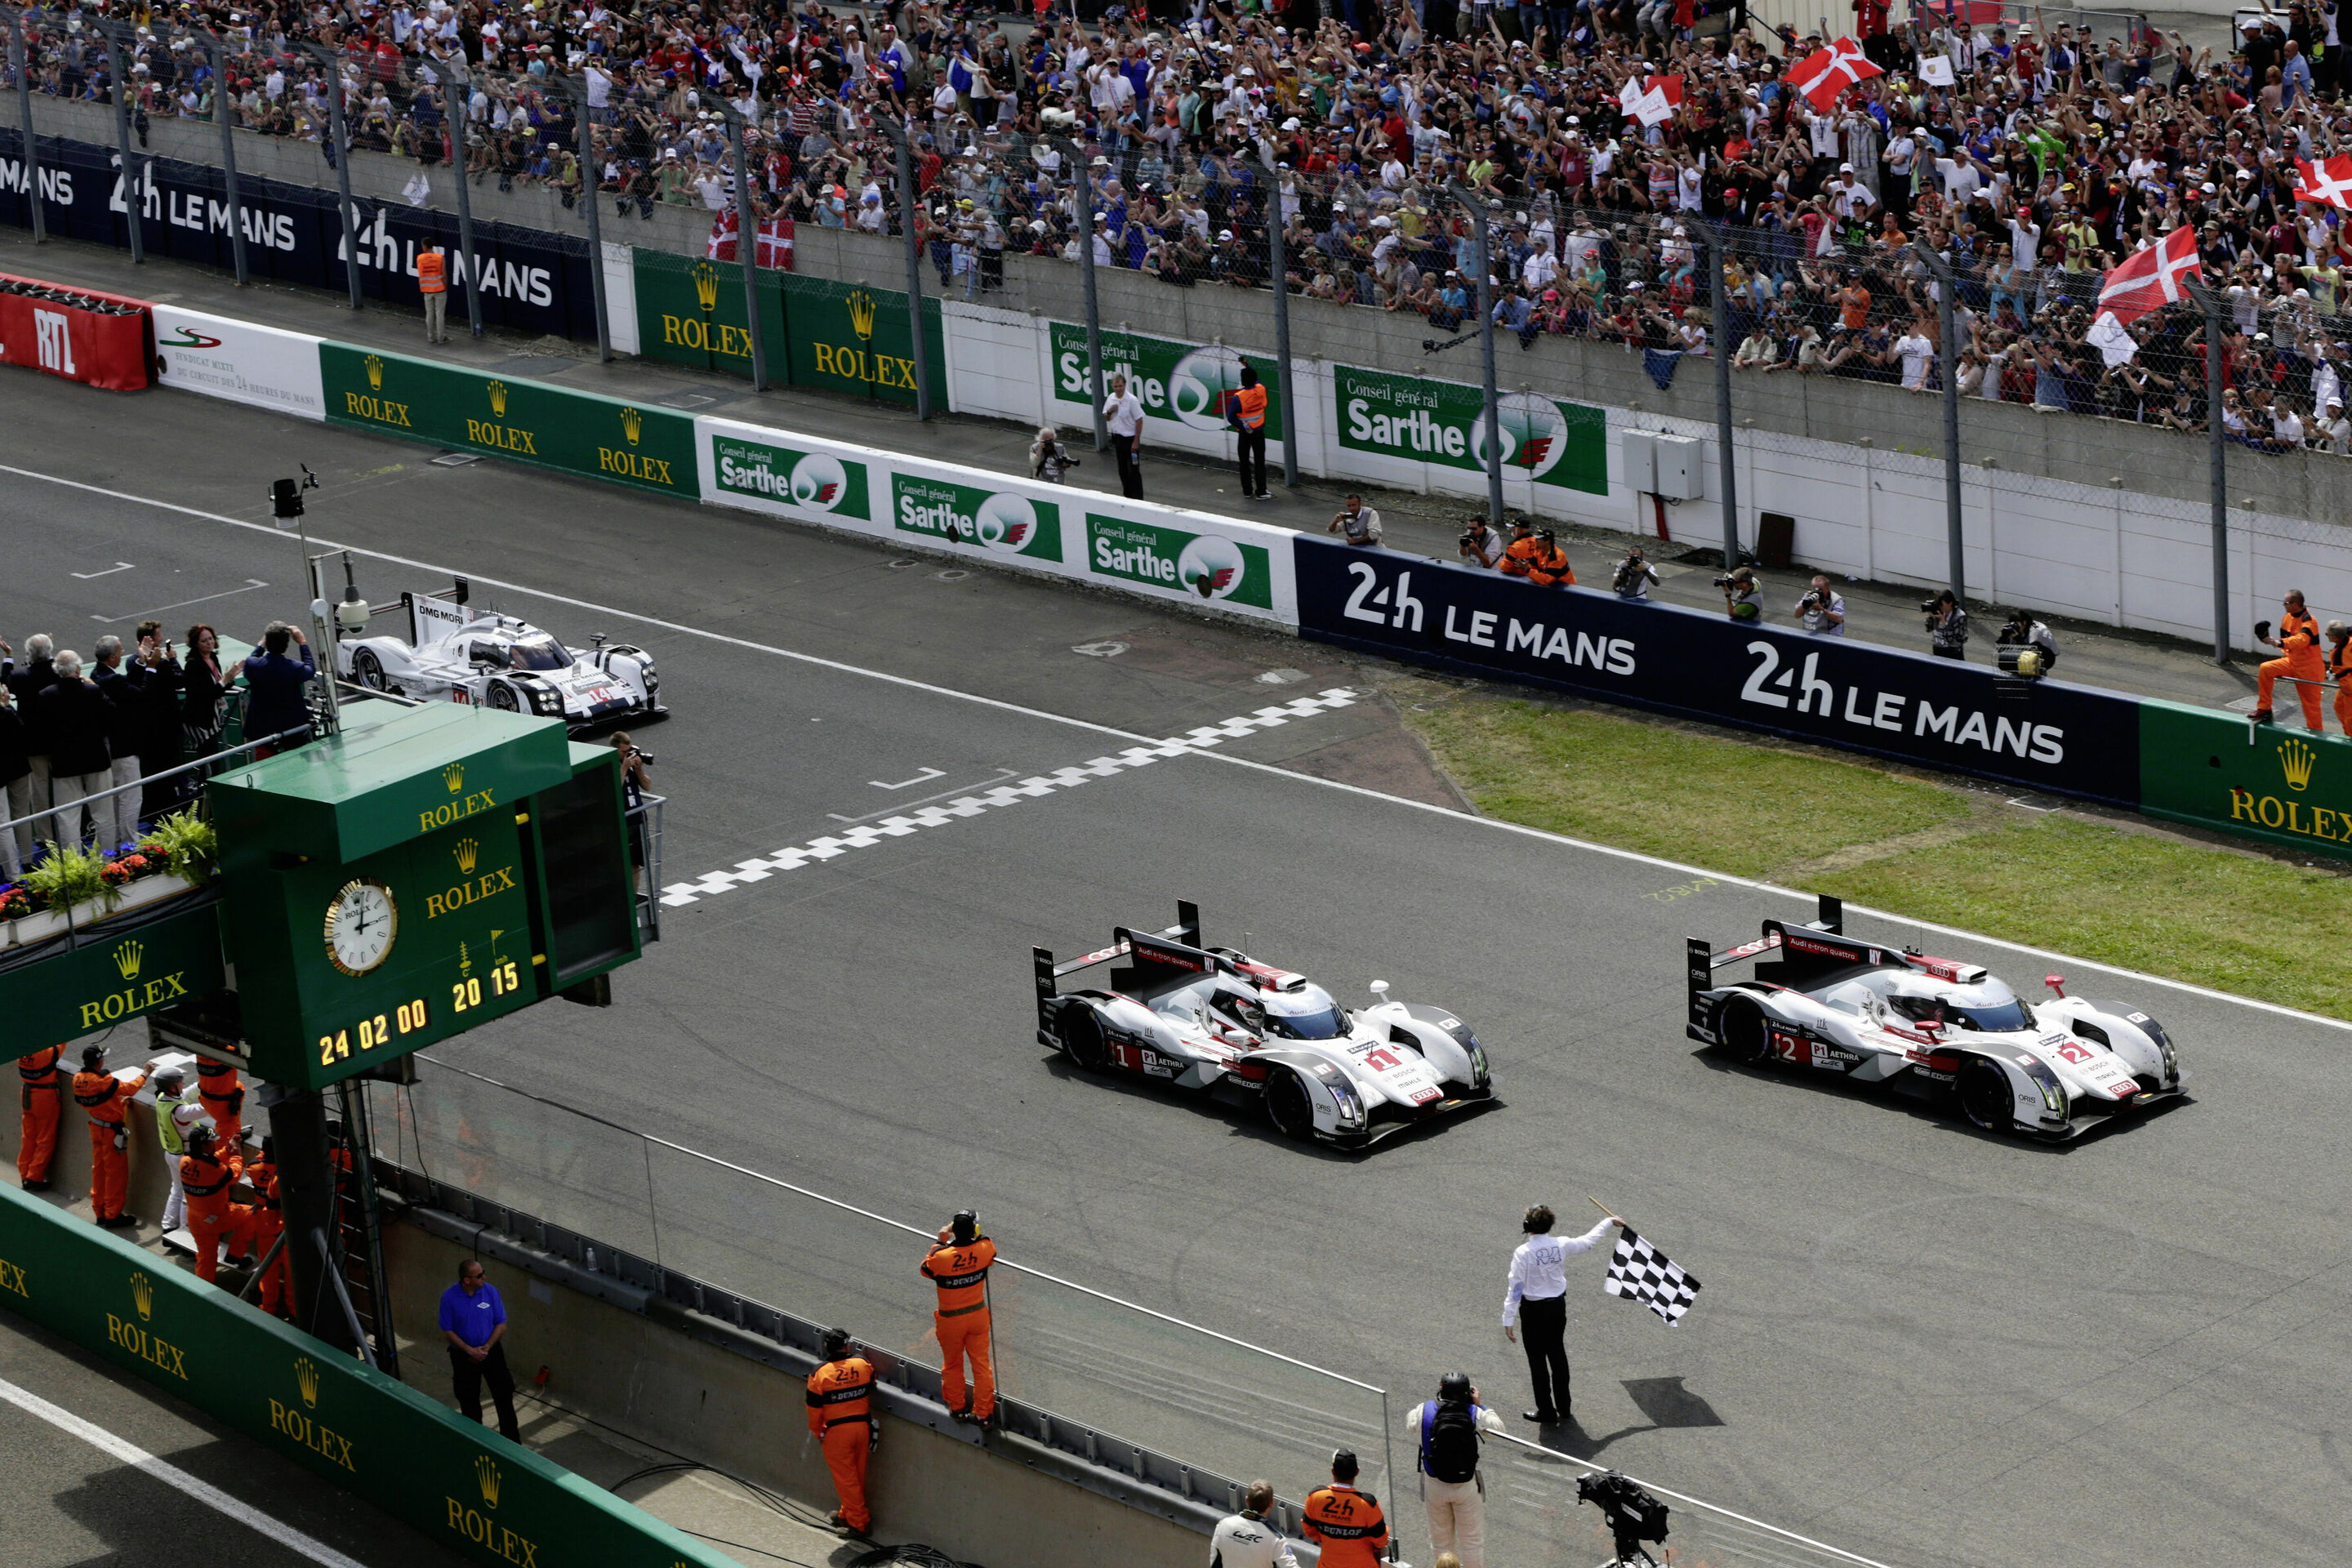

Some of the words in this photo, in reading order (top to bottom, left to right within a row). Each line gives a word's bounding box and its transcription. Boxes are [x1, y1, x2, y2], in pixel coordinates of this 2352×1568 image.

[170, 190, 203, 231] LE
[208, 199, 296, 252] MANS
[338, 202, 398, 273] 24h
[452, 249, 552, 307] MANS
[33, 308, 75, 375] RTL
[1058, 332, 1089, 352] Conse
[175, 351, 210, 368] SYNDICAT
[212, 358, 234, 372] MIXTE
[813, 342, 917, 390] ROLEX
[177, 368, 188, 376] DU
[190, 369, 219, 385] CIRCUIT
[221, 376, 235, 388] DES
[236, 375, 247, 391] 24
[249, 383, 278, 399] HEURES
[281, 390, 292, 400] DU
[294, 394, 315, 405] MANS
[1347, 377, 1391, 402] Conseil
[345, 392, 412, 427] ROLEX
[466, 419, 537, 455] ROLEX
[1348, 398, 1465, 457] Sarthe
[719, 443, 746, 460] Conseil
[746, 450, 773, 464] général
[598, 447, 674, 485] ROLEX
[720, 457, 789, 497] Sarthe
[899, 480, 927, 498] Conseil
[929, 488, 956, 503] général
[900, 494, 973, 537] Sarthe
[1094, 521, 1125, 540] Conseil
[1127, 529, 1157, 546] général
[1095, 537, 1176, 582] Sarthe
[419, 605, 439, 618] DMG
[441, 611, 463, 625] MORI
[1343, 561, 1423, 632] 24h
[1444, 604, 1498, 648] LE
[1506, 617, 1636, 676] MANS
[588, 687, 612, 703] 14
[1740, 641, 1833, 717] 24h
[1844, 686, 1906, 732] LE
[1915, 701, 2064, 764] MANS
[420, 788, 497, 832] ROLEX
[425, 866, 516, 919] ROLEX
[345, 905, 371, 920] ROLEX
[1138, 947, 1152, 956] Audi
[1153, 952, 1171, 961] e-tron
[1171, 958, 1193, 968] quattro
[1695, 949, 1709, 957] BOSCH
[1790, 938, 1806, 947] Audi
[1807, 943, 1829, 953] e-tron
[1829, 949, 1855, 960] quattro
[1869, 948, 1882, 965] HY
[1204, 956, 1214, 973] HY
[1691, 969, 1707, 978] ORIS
[491, 962, 519, 996] 15
[1038, 976, 1052, 986] ORIS
[79, 971, 188, 1029] ROLEX
[452, 978, 481, 1013] 20
[319, 1028, 350, 1066] 24
[359, 1014, 388, 1050] 02
[397, 999, 426, 1034] 00
[1444, 1020, 1458, 1028] P1
[1116, 1045, 1129, 1067] 1
[1144, 1052, 1155, 1064] P1
[1783, 1037, 1796, 1061] 2
[1814, 1045, 1825, 1056] P1
[1830, 1050, 1859, 1061] AETHRA
[2062, 1047, 2090, 1064] 2
[1158, 1058, 1184, 1068] AETHRA
[1371, 1054, 1396, 1071] 1
[1392, 1067, 1416, 1079] BOSCH
[2087, 1061, 2109, 1071] BOSCH
[1242, 1080, 1263, 1089] EDGE
[1397, 1078, 1423, 1089] MAHLE
[1931, 1071, 1956, 1082] EDGE
[2095, 1070, 2118, 1080] MAHLE
[1316, 1102, 1331, 1112] ORIS
[2018, 1094, 2036, 1103] ORIS
[952, 1251, 978, 1267] 24h
[952, 1272, 983, 1285] DUNLOP
[106, 1312, 189, 1381] ROLEX
[835, 1366, 860, 1381] 24h
[838, 1388, 866, 1400] DUNLOP
[269, 1397, 356, 1472] ROLEX
[1322, 1495, 1354, 1517] 24h
[445, 1495, 538, 1568] ROLEX
[1232, 1530, 1263, 1544] WEC
[1323, 1526, 1362, 1536] DUNLOP
